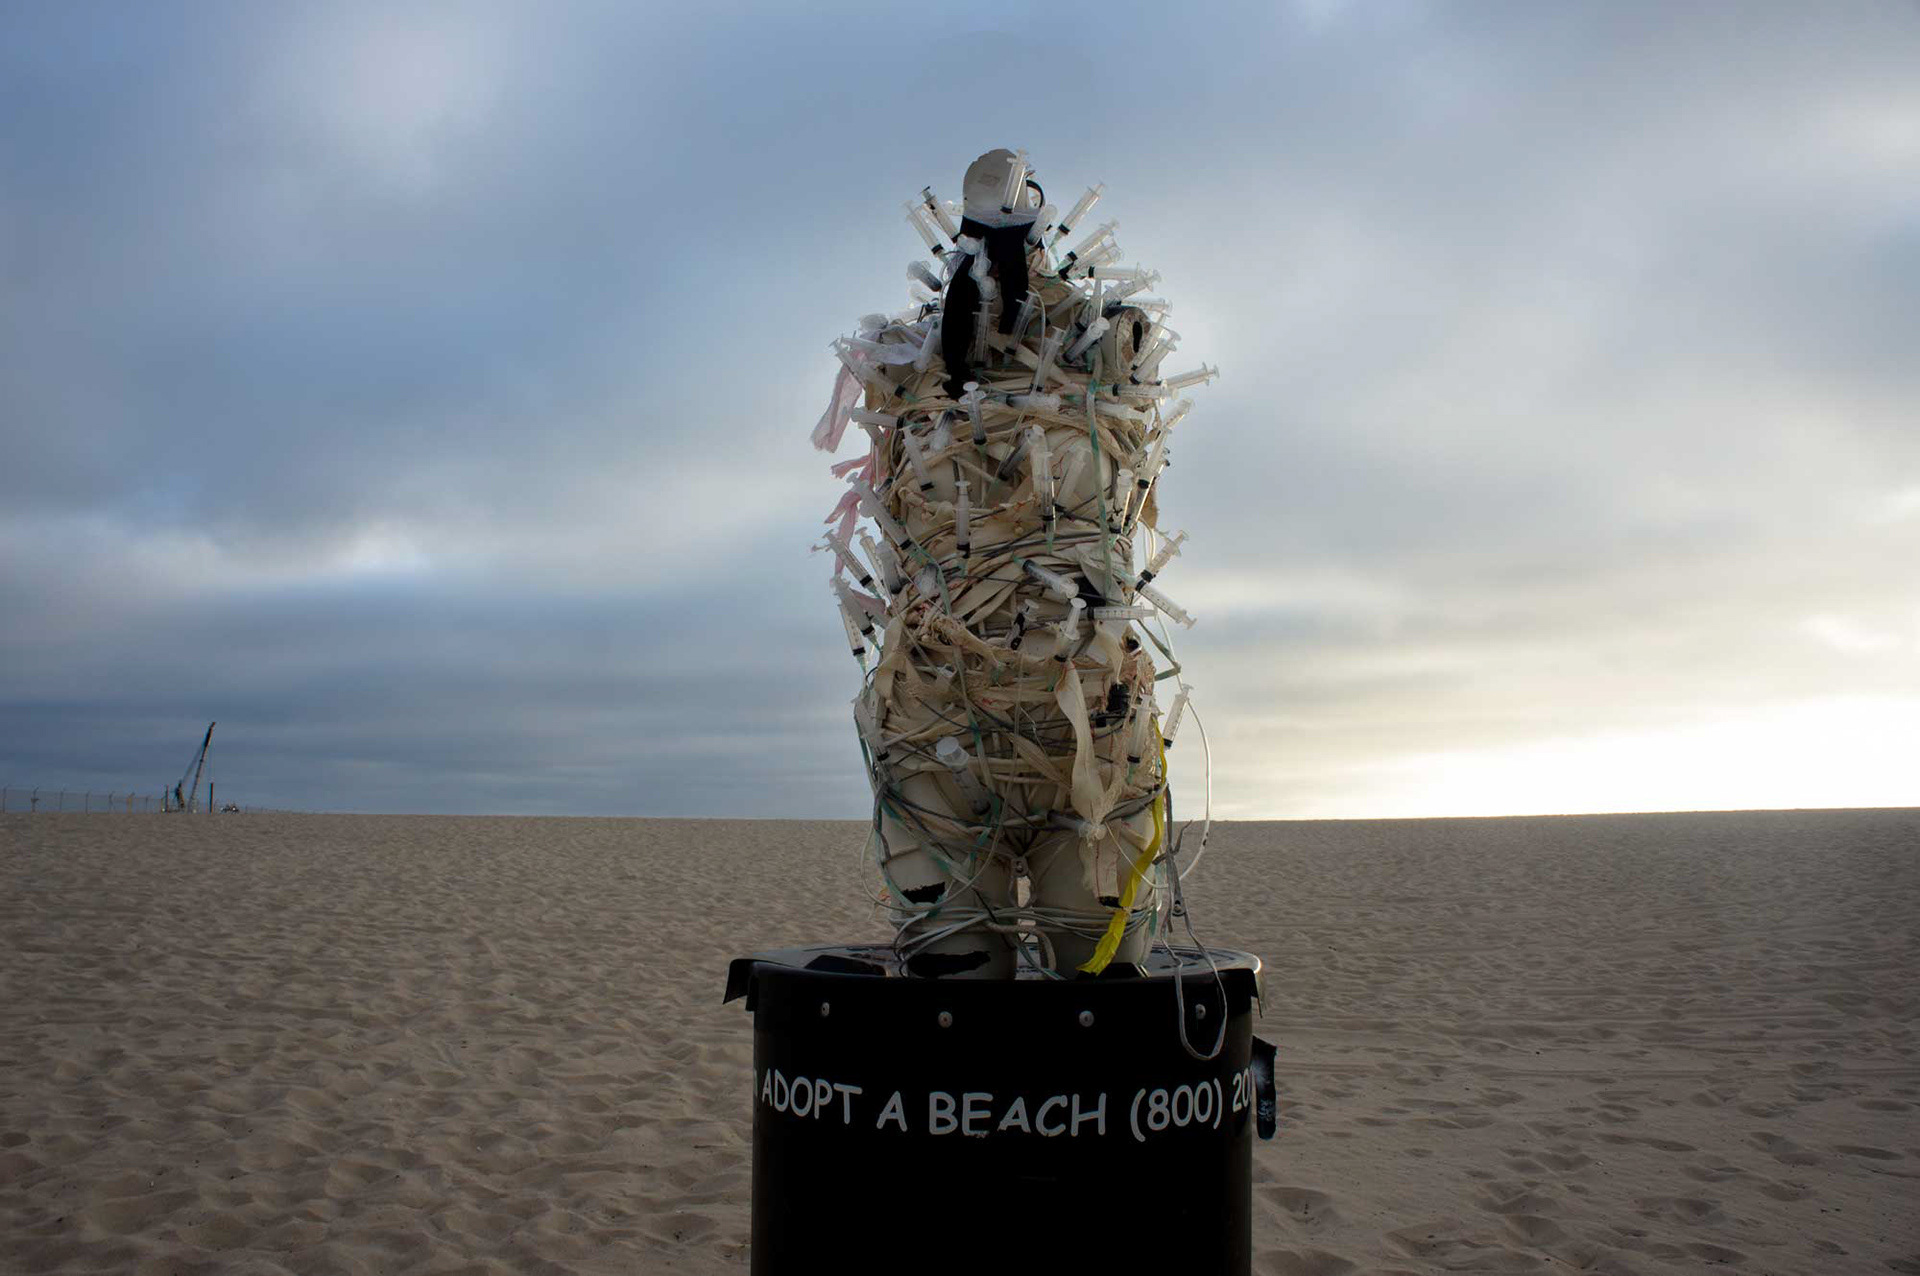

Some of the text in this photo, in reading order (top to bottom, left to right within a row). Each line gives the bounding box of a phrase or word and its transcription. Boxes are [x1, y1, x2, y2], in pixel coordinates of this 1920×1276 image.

[762, 1068, 863, 1125] ADOPT
[876, 1090, 908, 1132] A
[929, 1091, 1107, 1137] BEACH
[1130, 1078, 1223, 1143] (800)
